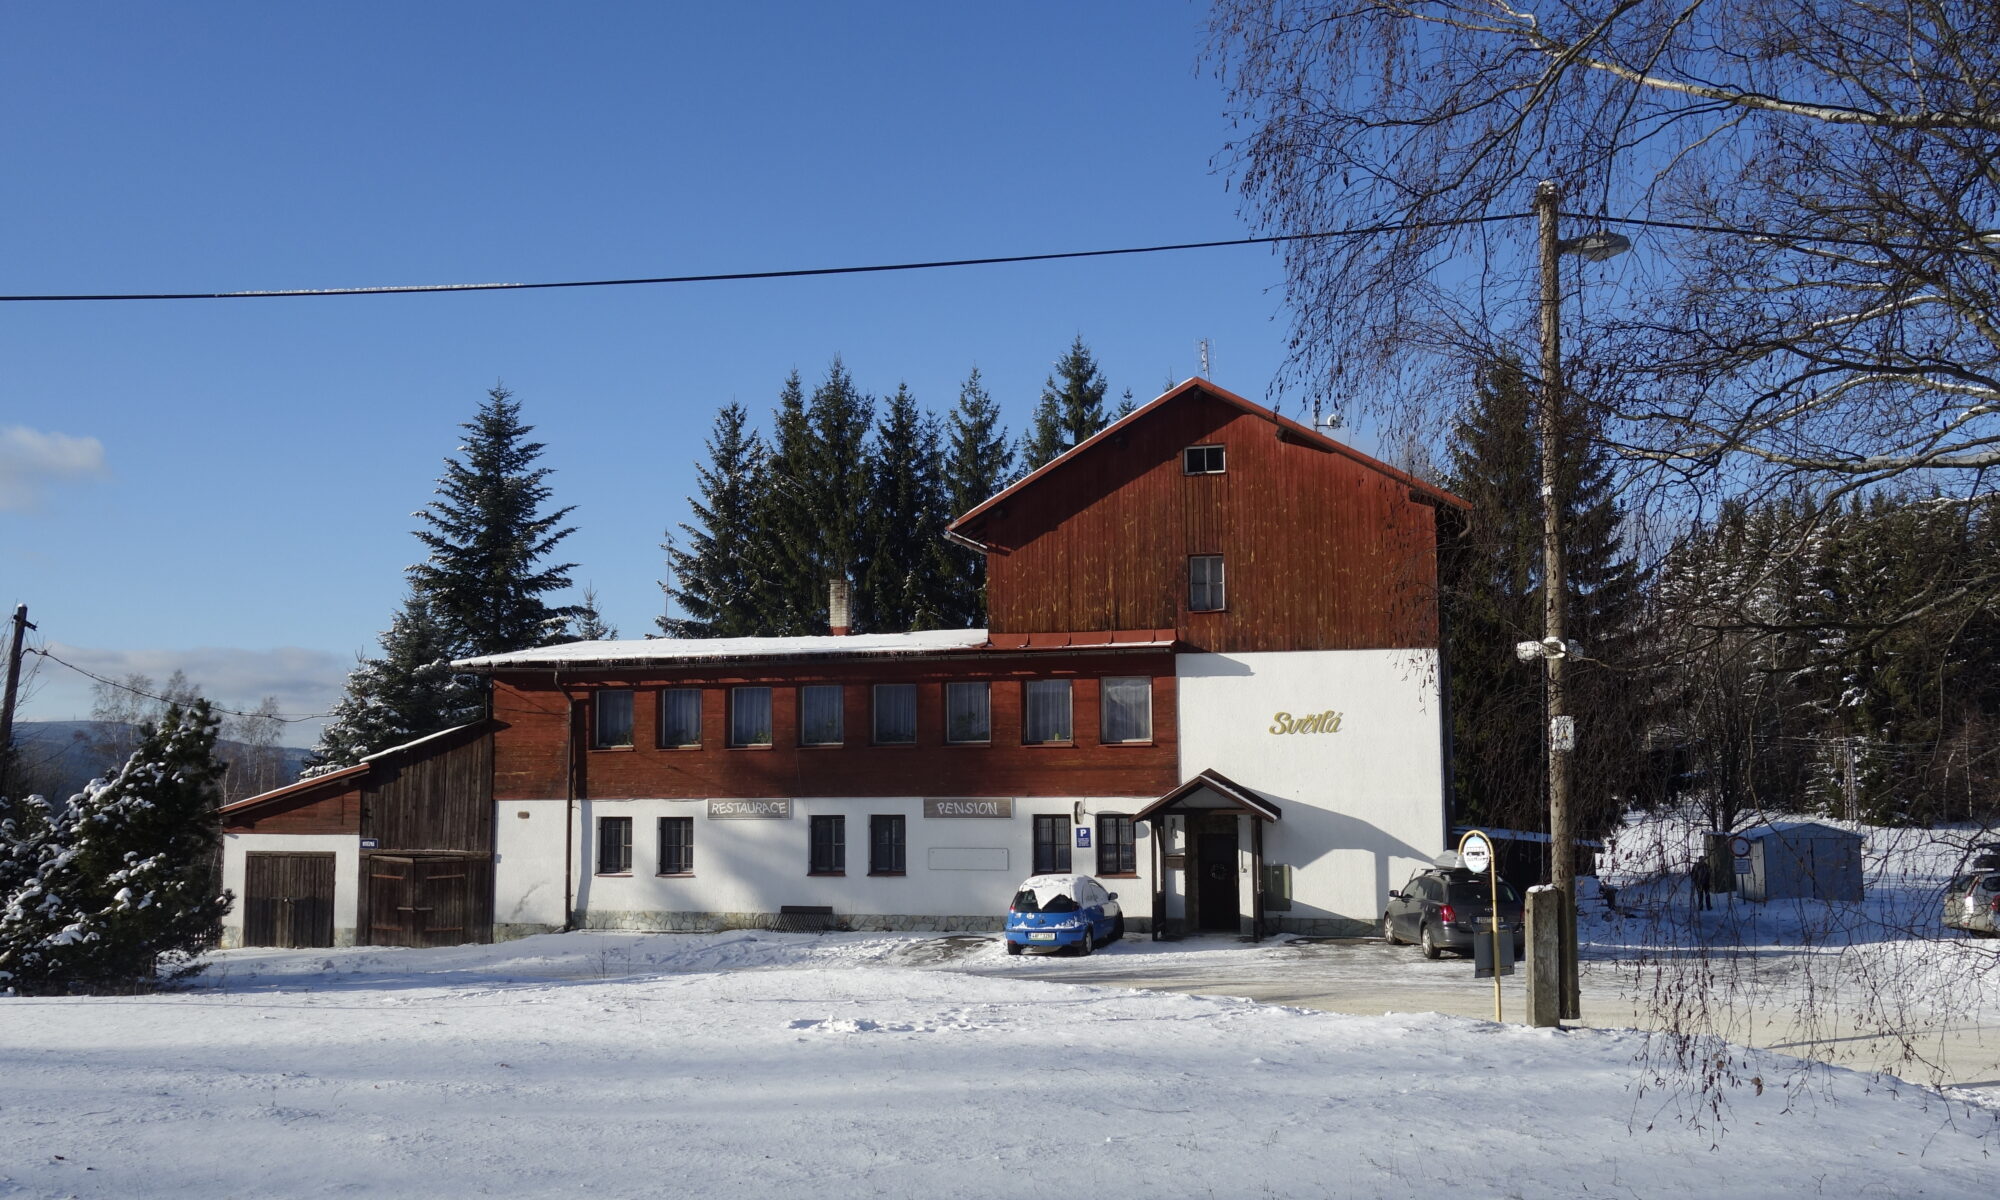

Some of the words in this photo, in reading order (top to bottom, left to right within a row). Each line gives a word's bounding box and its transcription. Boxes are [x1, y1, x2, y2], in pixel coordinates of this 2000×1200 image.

[711, 802, 787, 815] RESTAURACE
[936, 802, 998, 815] PENSION
[1080, 829, 1087, 837] P
